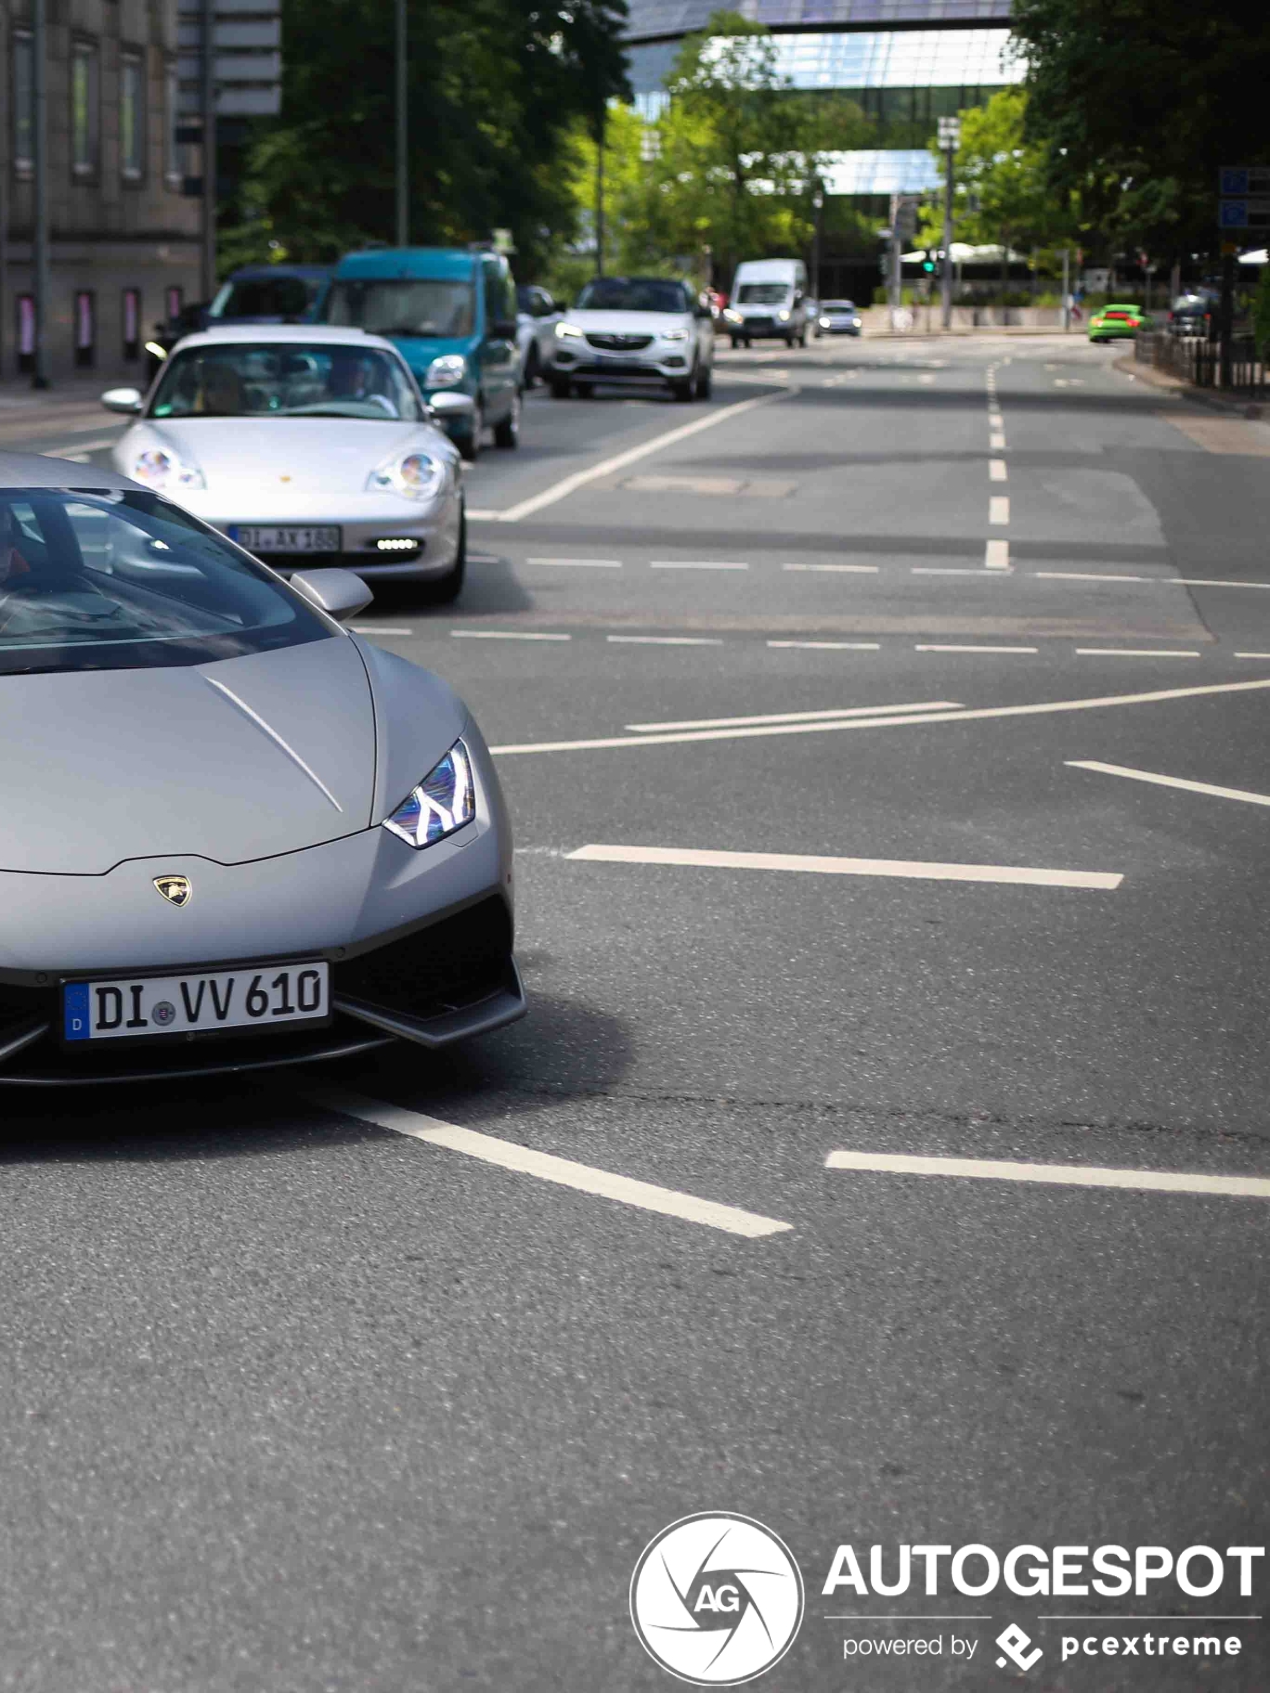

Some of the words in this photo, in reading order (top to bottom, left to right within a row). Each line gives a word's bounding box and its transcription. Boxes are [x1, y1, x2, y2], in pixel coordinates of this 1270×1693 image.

[72, 1017, 82, 1031] D
[95, 984, 149, 1031] DI
[180, 977, 235, 1024] VV
[245, 969, 322, 1018] 610
